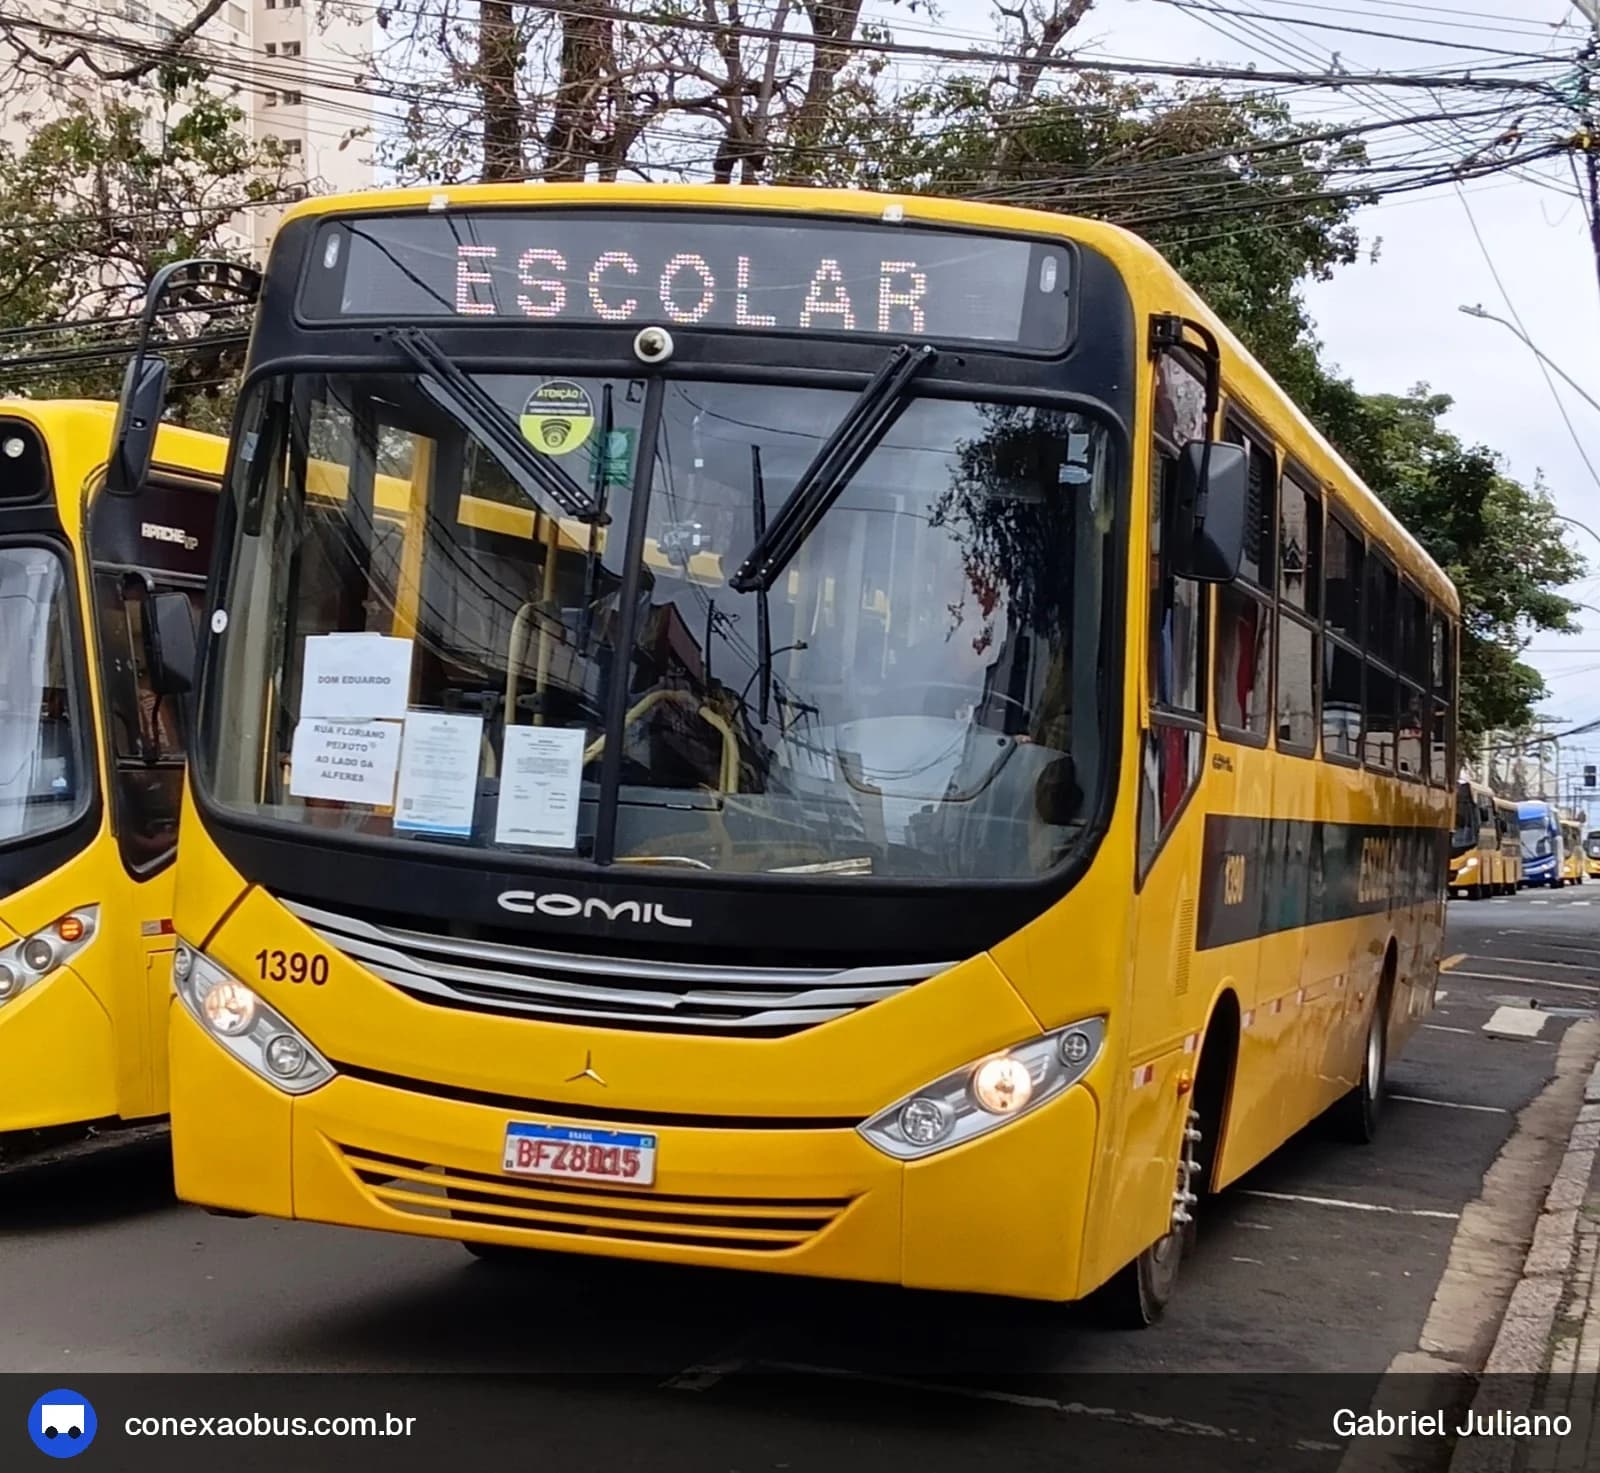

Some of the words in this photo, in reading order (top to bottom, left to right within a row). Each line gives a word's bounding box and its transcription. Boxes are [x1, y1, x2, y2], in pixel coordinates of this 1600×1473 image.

[456, 245, 928, 333] ESCOLAR
[318, 676, 339, 684] DOM
[342, 676, 391, 685] EDUARDO
[314, 725, 334, 734] RUA
[336, 727, 385, 739] FLORIANO
[326, 741, 368, 752] PEIXOTO
[321, 771, 364, 782] ALFERES
[497, 890, 693, 928] COMIL
[256, 949, 329, 986] 1390
[516, 1138, 641, 1178] BFZ8D15
